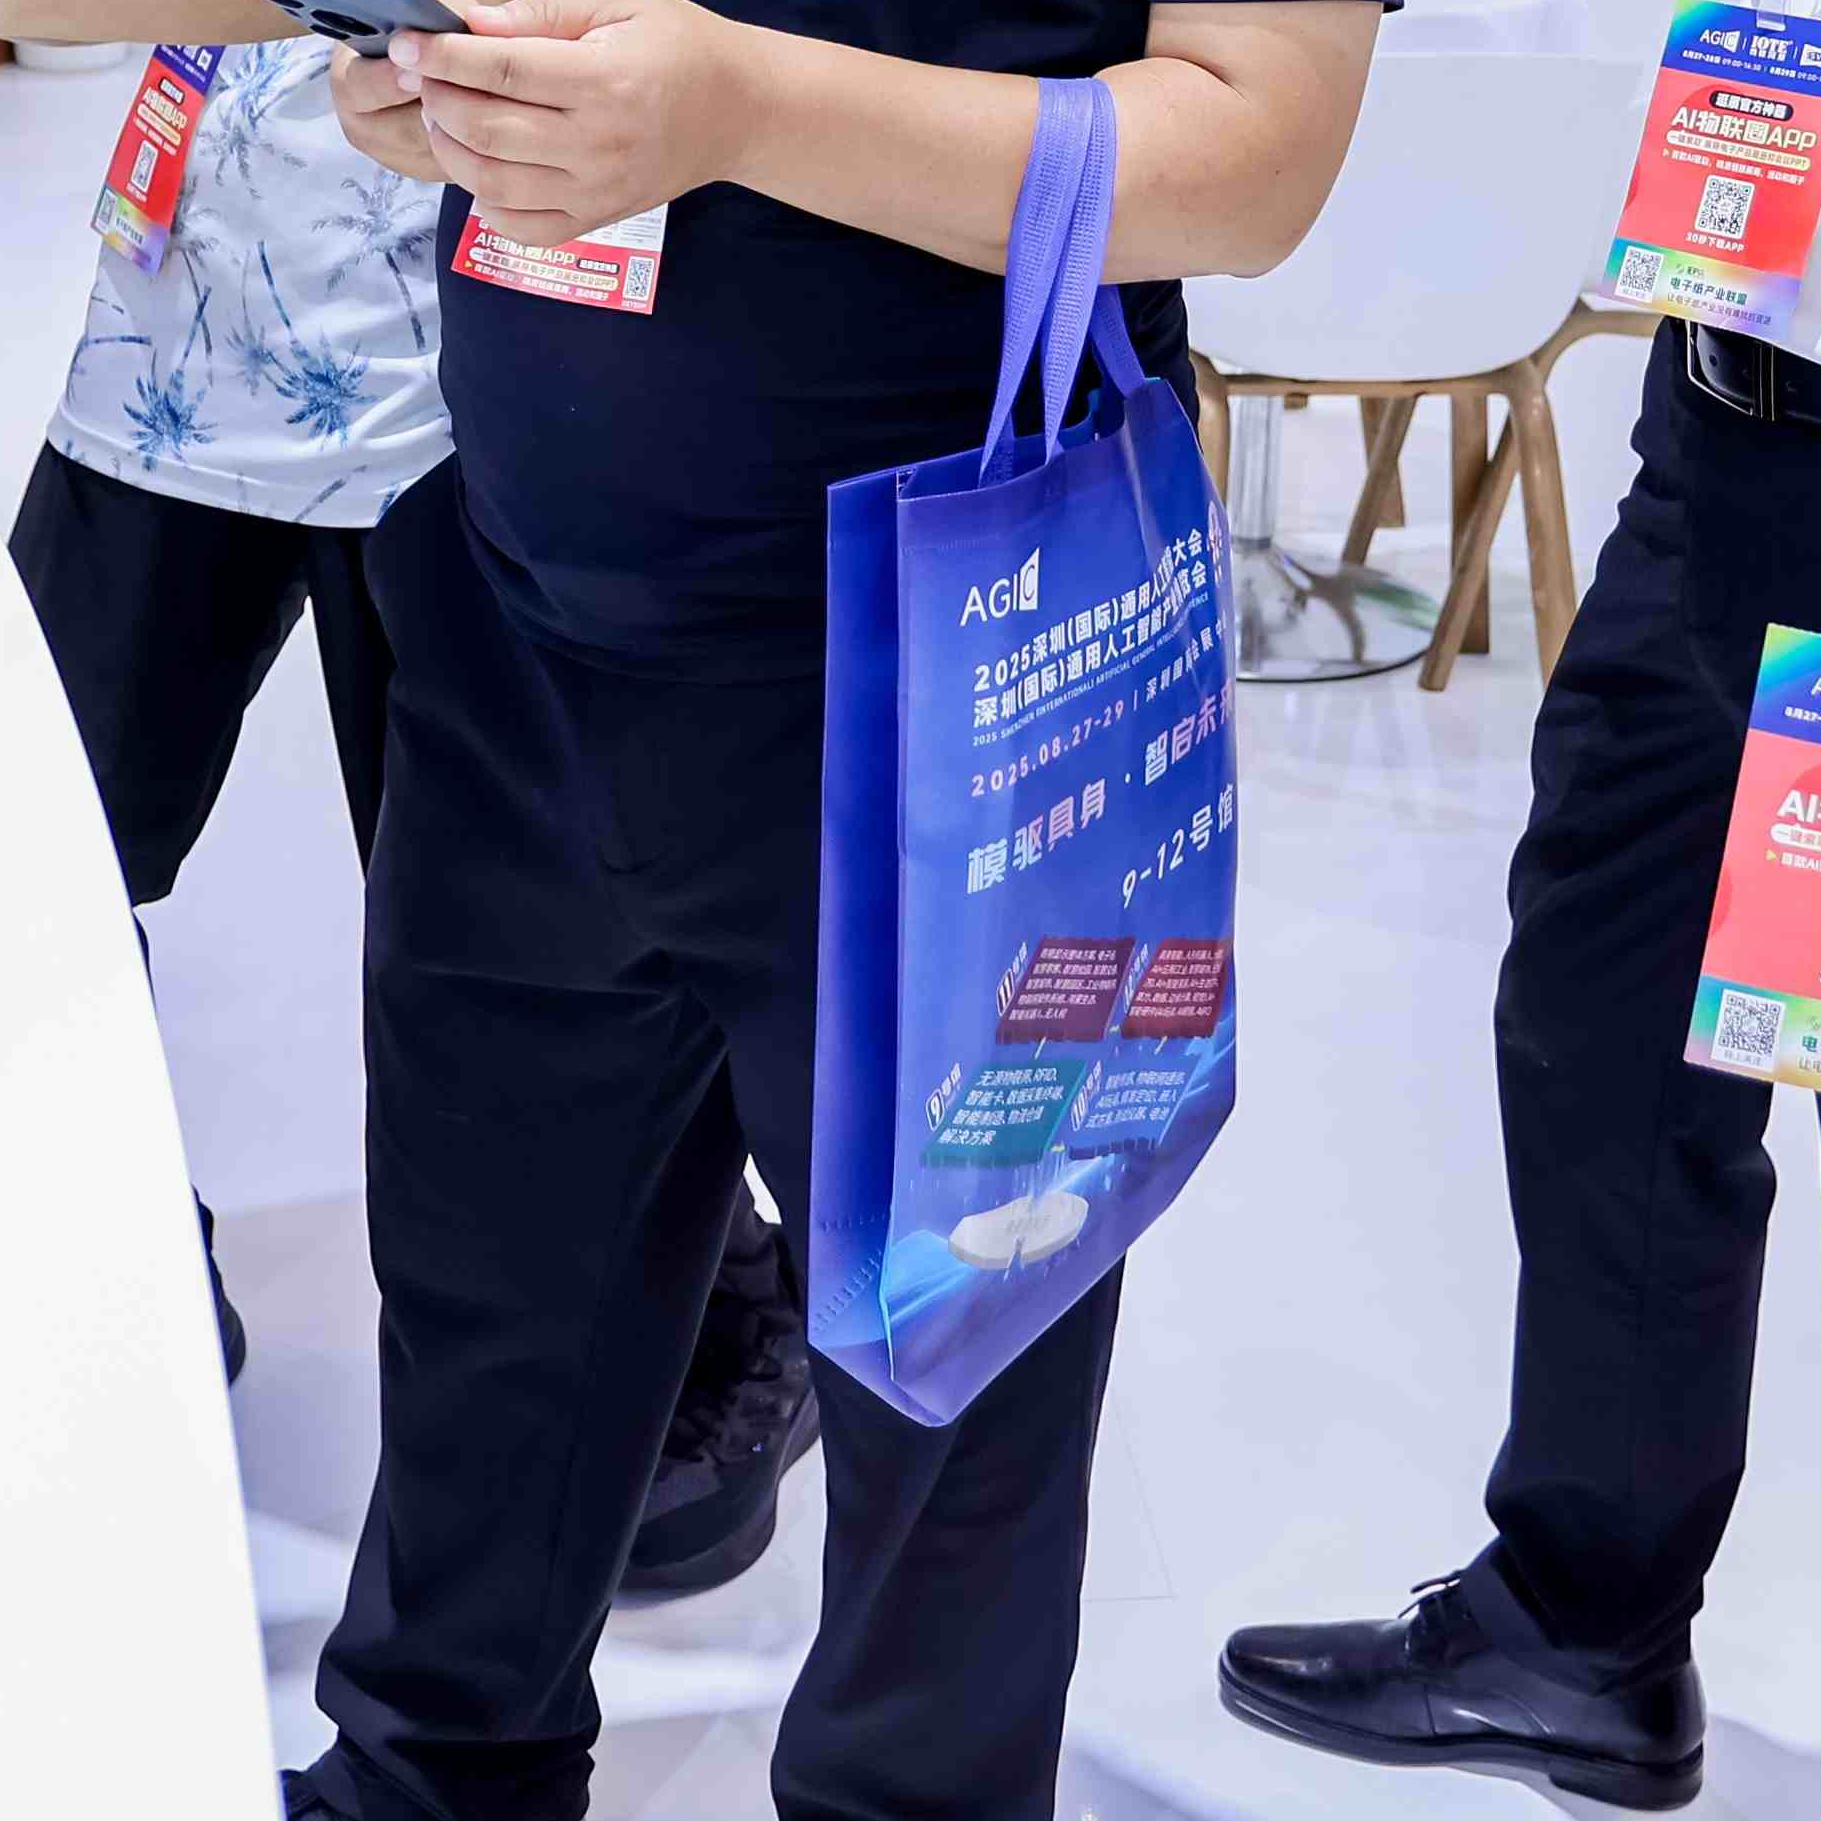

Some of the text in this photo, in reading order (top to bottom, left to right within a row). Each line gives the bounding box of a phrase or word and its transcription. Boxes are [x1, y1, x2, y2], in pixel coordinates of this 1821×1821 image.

[1697, 24, 1740, 52] AGIC
[1750, 34, 1789, 54] IOTE
[1672, 106, 1817, 151] AI物联圈APP
[1670, 277, 1748, 305] 电子纸产业联盟
[960, 547, 1041, 627] AGIC
[971, 698, 1125, 798] 2025.08.27-29
[967, 778, 1106, 894] 模驱具身
